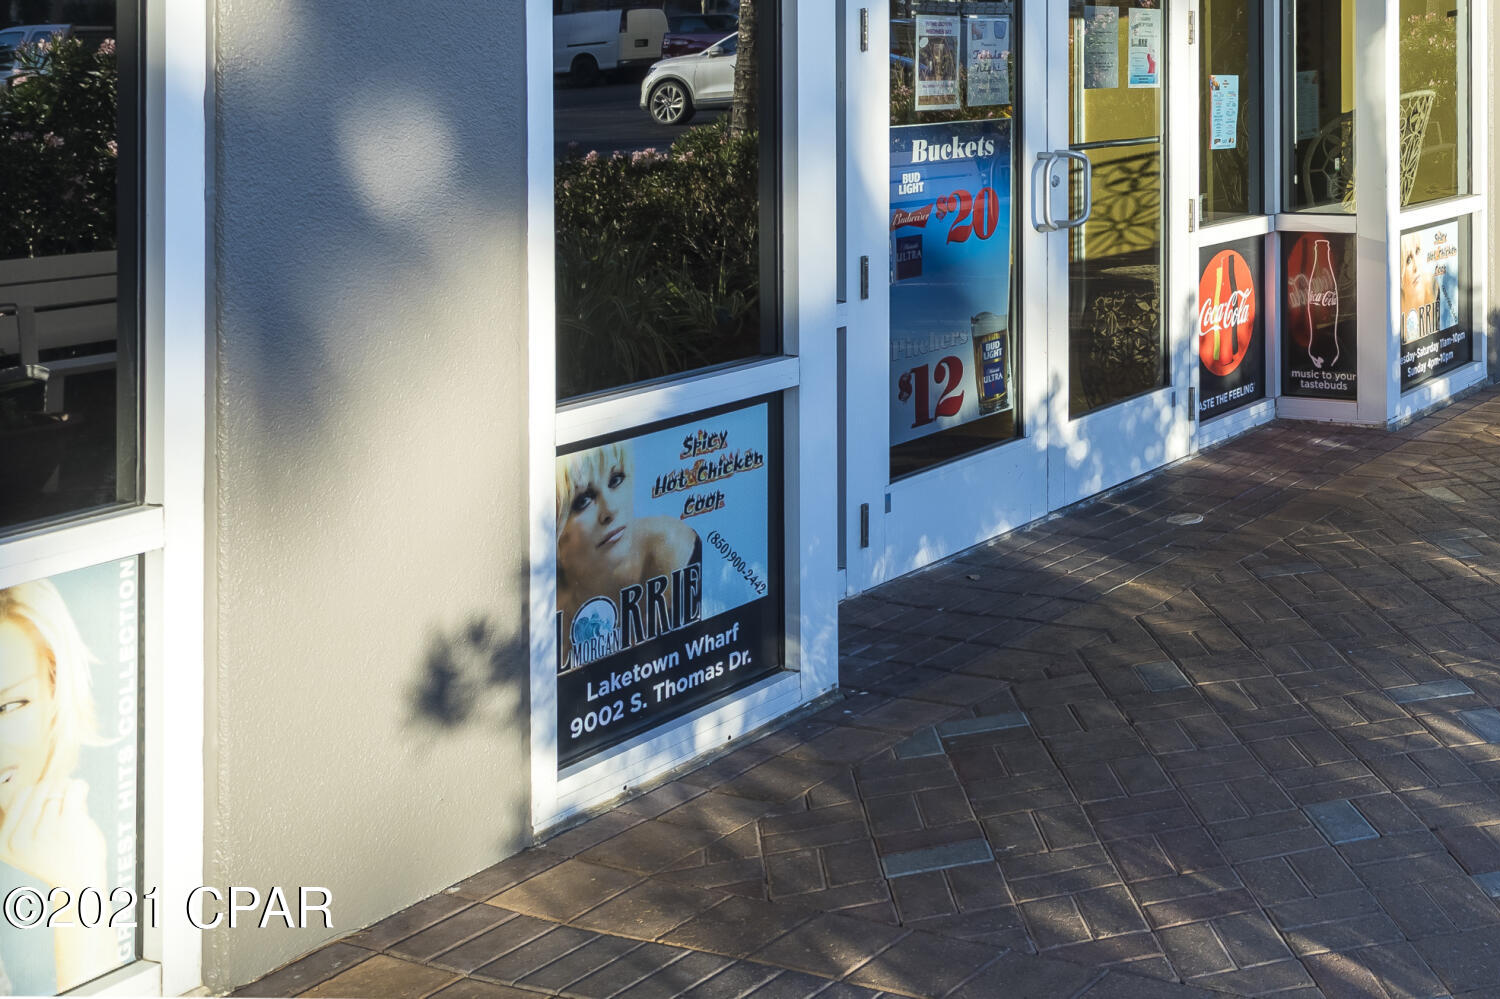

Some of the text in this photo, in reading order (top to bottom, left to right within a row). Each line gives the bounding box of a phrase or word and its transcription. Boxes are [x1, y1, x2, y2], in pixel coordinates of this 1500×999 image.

[911, 136, 995, 163] Buckets
[898, 182, 925, 196] LIGHT
[902, 172, 921, 184] BUD
[892, 212, 930, 226] Budweiser
[936, 187, 1000, 245] $20
[896, 249, 922, 262] ULTRA
[1199, 287, 1253, 336] Coca-Cola
[983, 347, 1003, 360] LIGHT
[985, 340, 1000, 352] BUD
[1400, 342, 1439, 365] esday-Saturday
[984, 372, 1003, 384] ULTRA
[1291, 369, 1357, 385] music to your
[1408, 362, 1427, 378] Sunday
[898, 355, 965, 429] $12
[1199, 382, 1255, 411] ASTE THE FEELING
[1300, 380, 1348, 391] tastebuds
[681, 430, 729, 460] Spicy
[652, 449, 764, 498] Hot Chicken
[681, 490, 726, 520] Coop
[706, 530, 767, 595] (850)900-2442
[117, 558, 137, 739] COLLECTION
[572, 627, 623, 668] MORGAN
[586, 622, 740, 702] Laketown Wharf
[570, 649, 752, 739] 9002 S. Thomas Dr.
[117, 749, 136, 810] HITS
